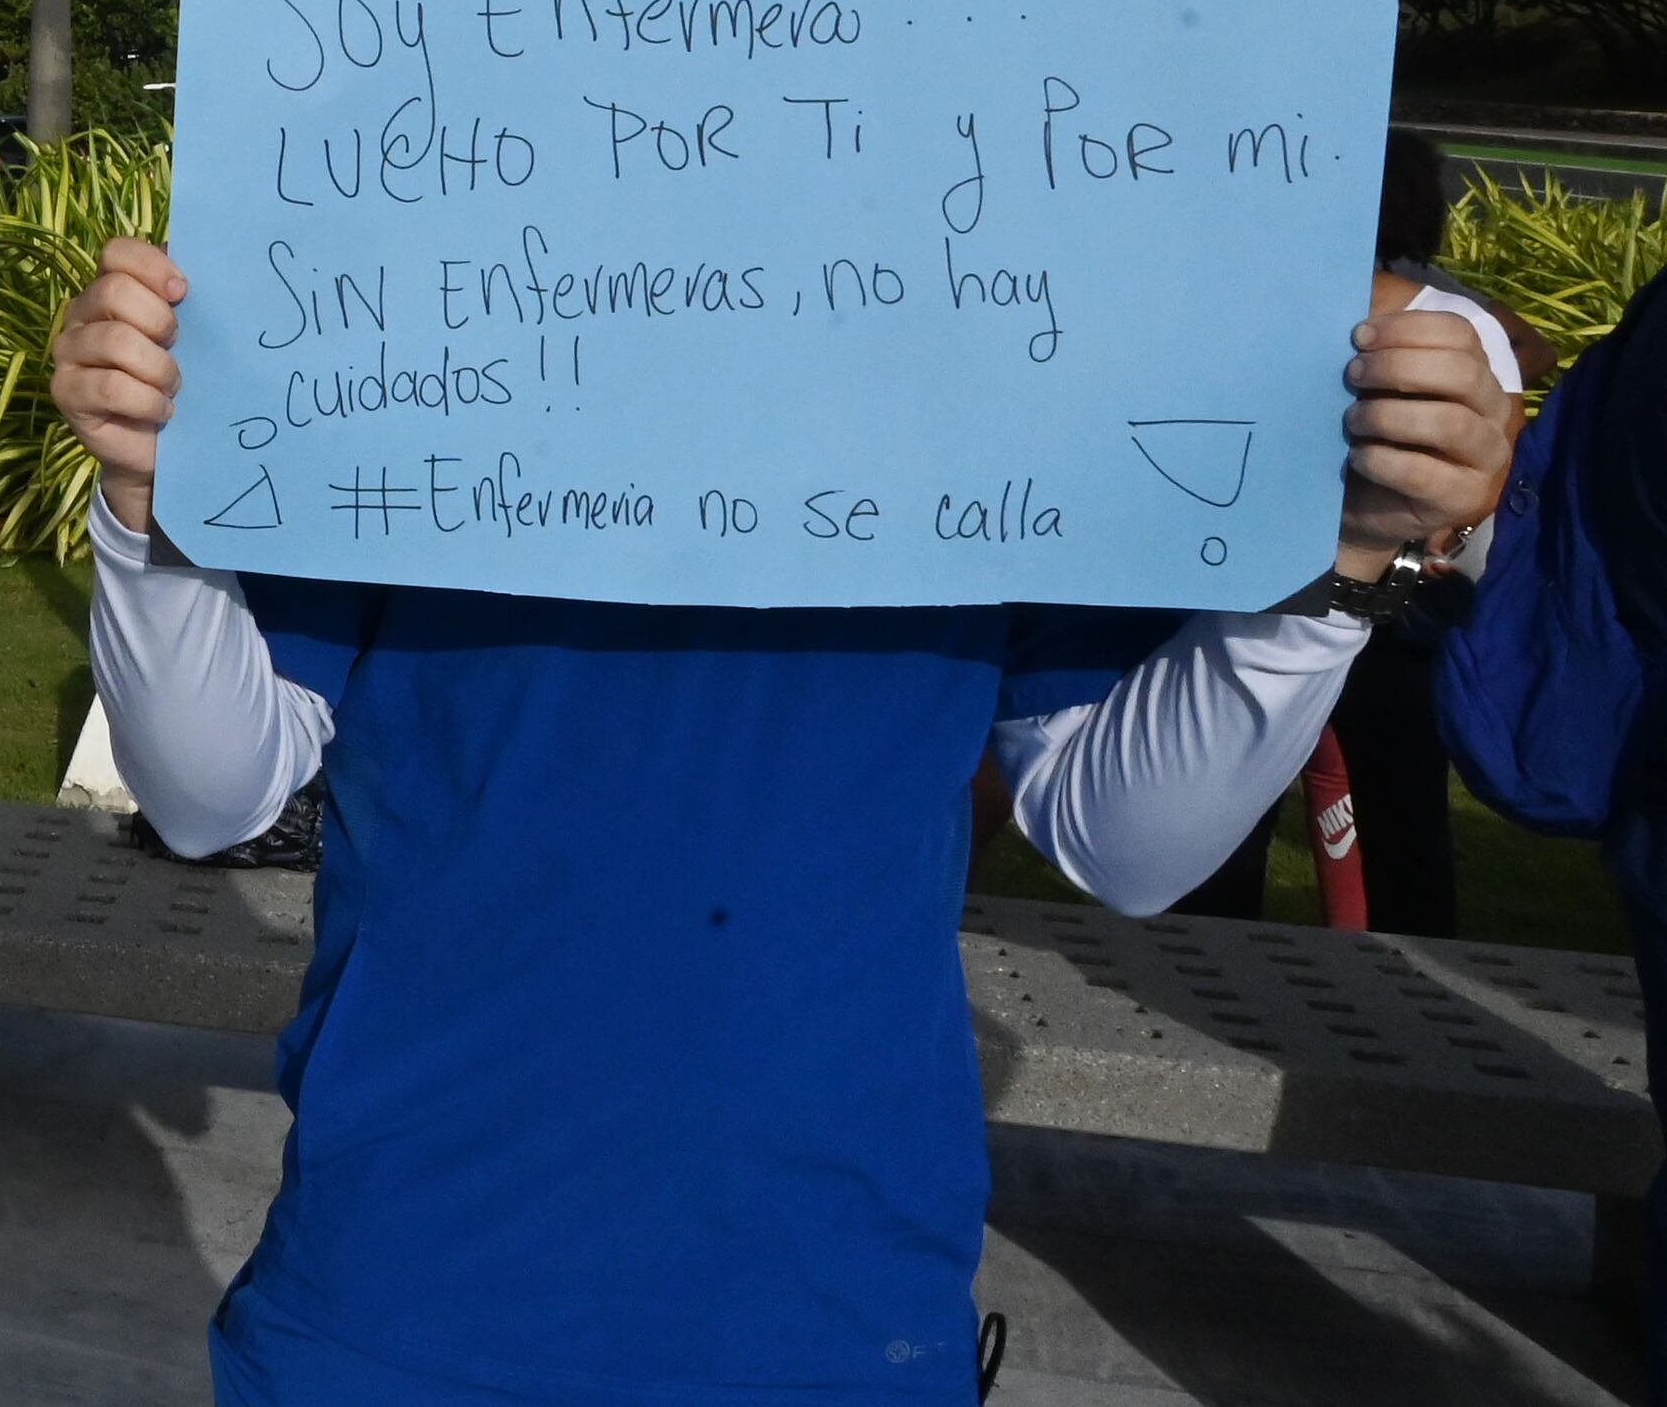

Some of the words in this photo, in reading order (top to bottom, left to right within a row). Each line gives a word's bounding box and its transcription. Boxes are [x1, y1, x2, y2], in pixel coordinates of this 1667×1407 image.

[582, 95, 740, 180] POR
[782, 95, 864, 160] Ti
[822, 258, 905, 312] no
[944, 236, 1065, 363] hay
[699, 488, 759, 538] no
[934, 477, 1064, 544] calla
